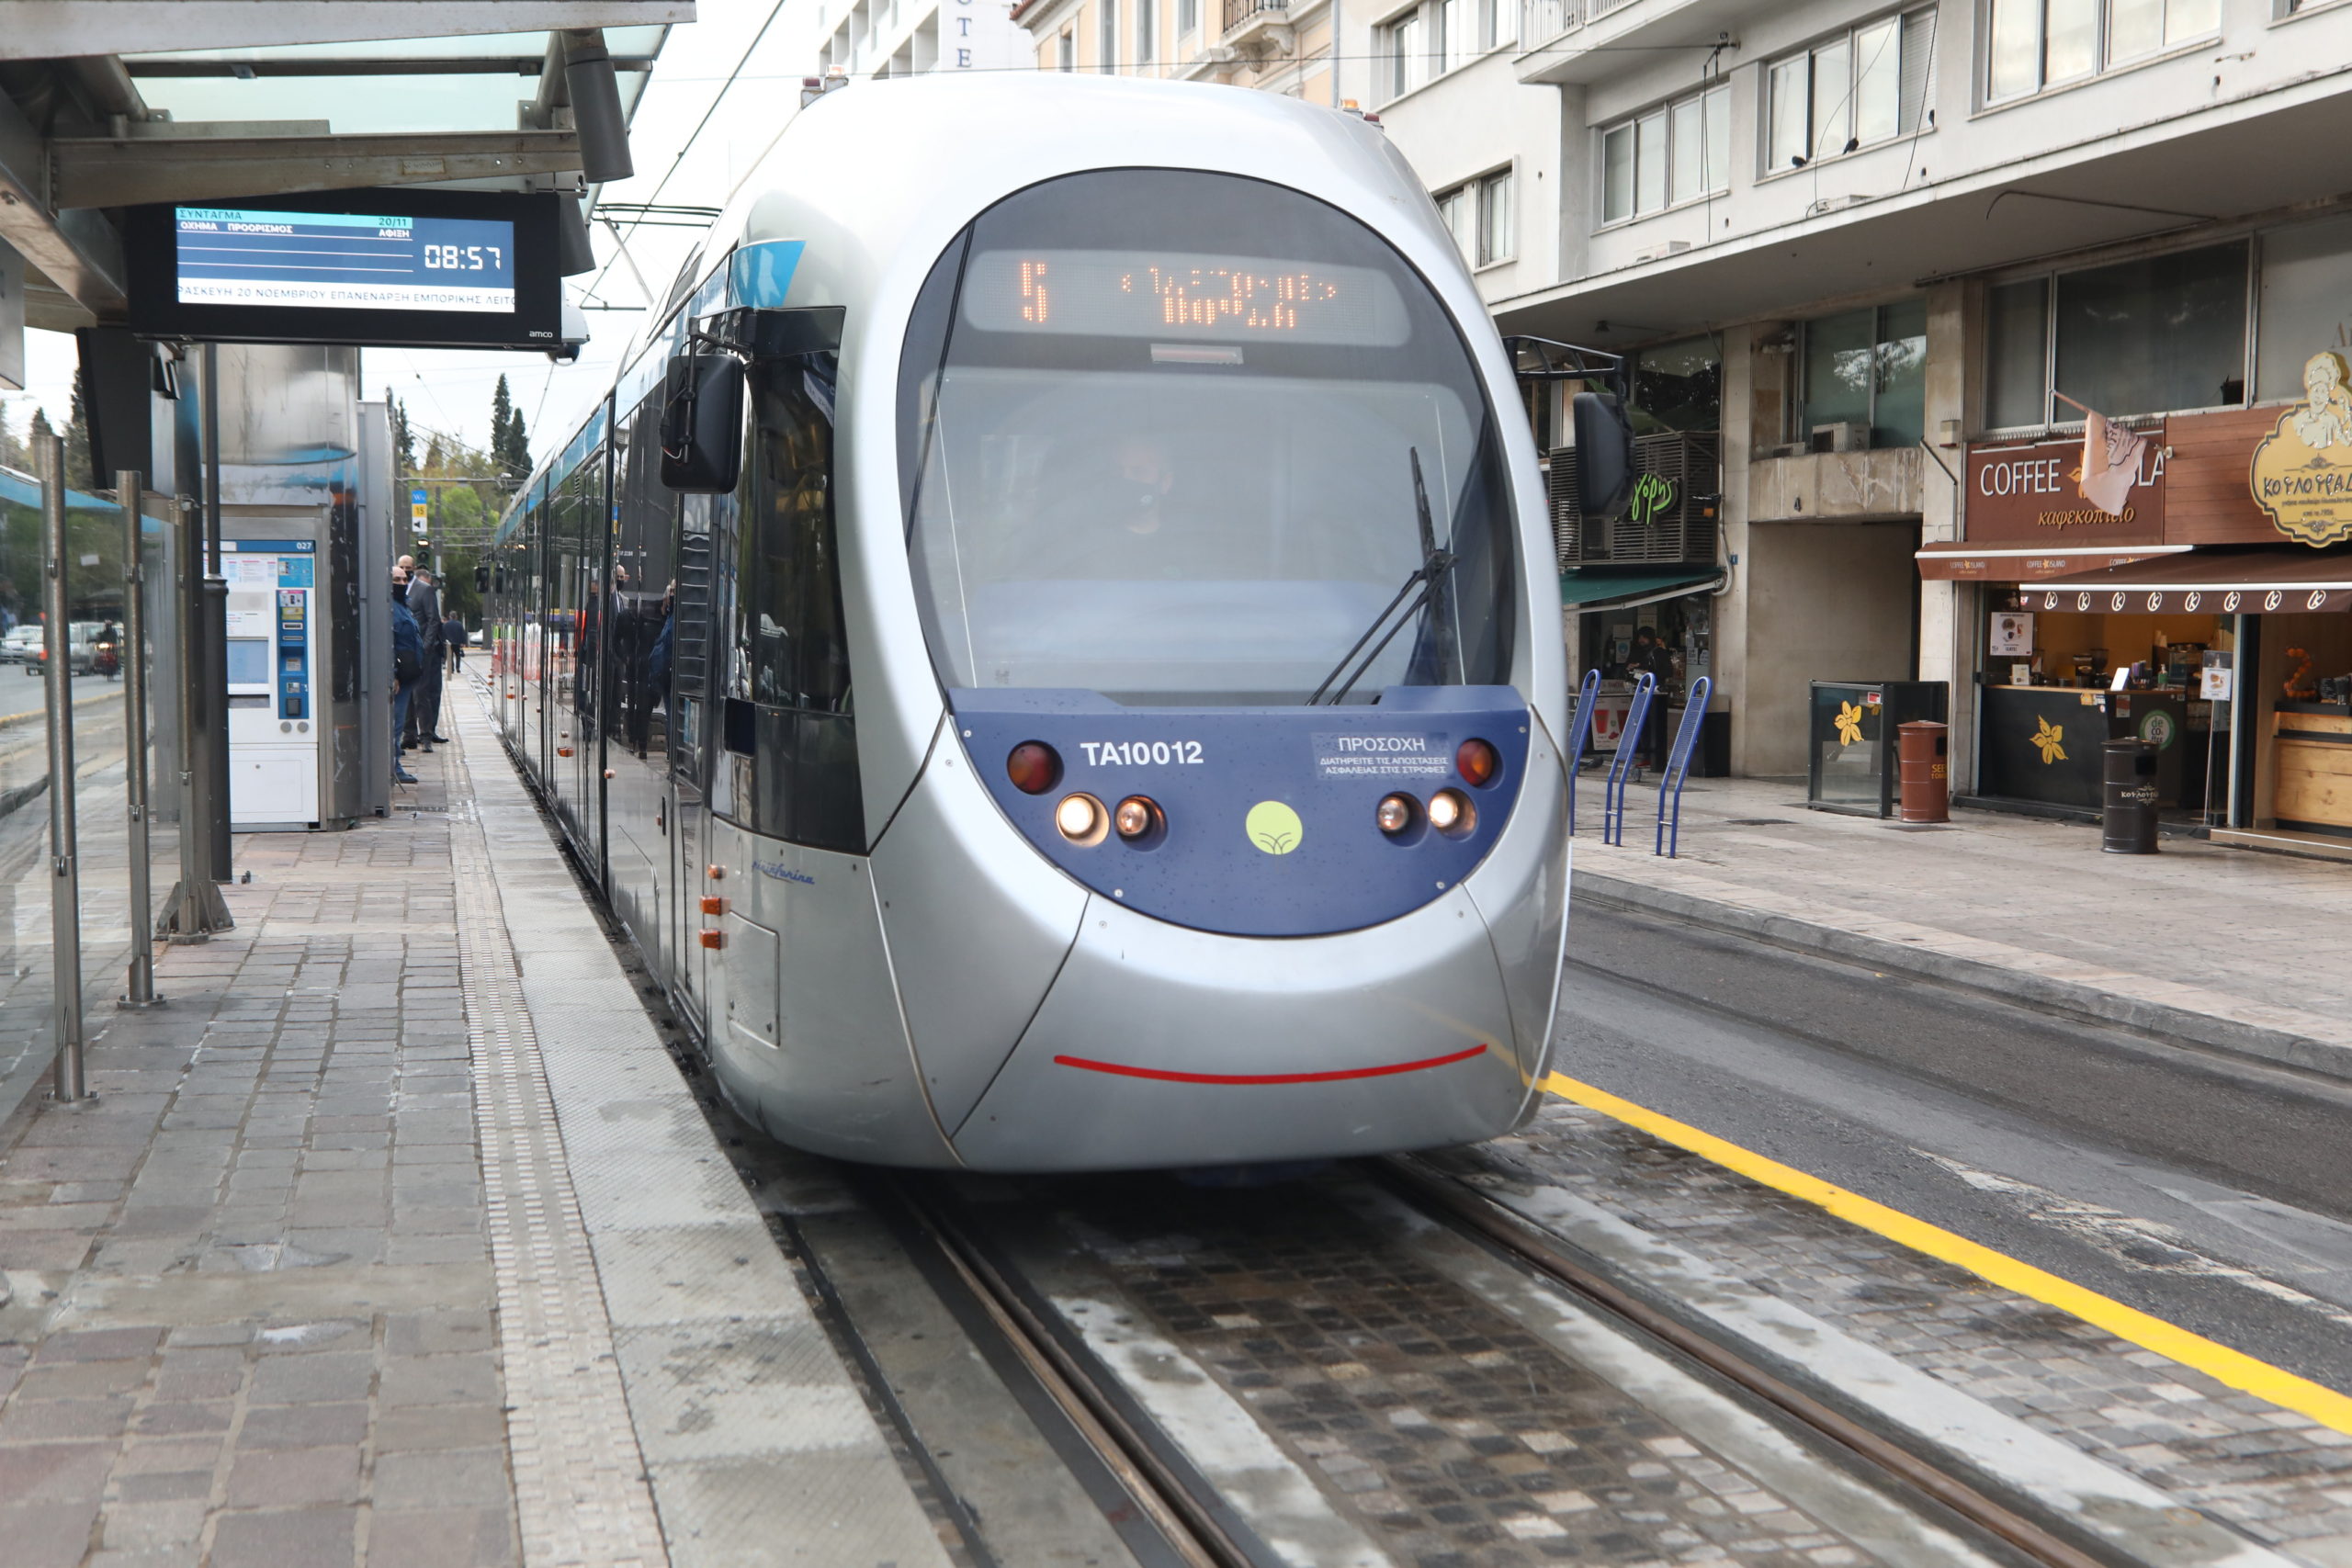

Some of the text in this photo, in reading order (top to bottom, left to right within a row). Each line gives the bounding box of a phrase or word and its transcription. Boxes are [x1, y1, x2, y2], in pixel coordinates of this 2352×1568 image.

[956, 0, 972, 68] TE
[179, 209, 243, 220] ΣΥΝΤΑΓΜΑ
[379, 217, 407, 227] 20/11
[180, 221, 410, 239] ΟΧΗΜΑ ΠΡΟΟΡΙΣΜΟΣ ΑΦΙΞΗ
[424, 244, 501, 270] 08:57
[237, 288, 252, 297] 20
[255, 288, 327, 299] ΝΟΕΜΒΡΙΟΥ
[413, 293, 482, 304] ΕΜΠΟΡΙΚΗΣ
[528, 330, 554, 339] amco
[1979, 458, 2063, 497] COFFEE
[296, 541, 312, 550] 027
[2026, 558, 2066, 569] COFFEE ISLAND
[1338, 738, 1426, 751] ΠΡΟΣΟΧΗ
[1080, 740, 1204, 767] TA10012
[1319, 757, 1449, 765] ΔΙΑΤΗΡΕΙΤΕ ΤΙΣ ΑΠΟΣΤΑΣΕΙΣ
[1326, 766, 1379, 774] ΑΣΦΑΛΕΙΑΣ
